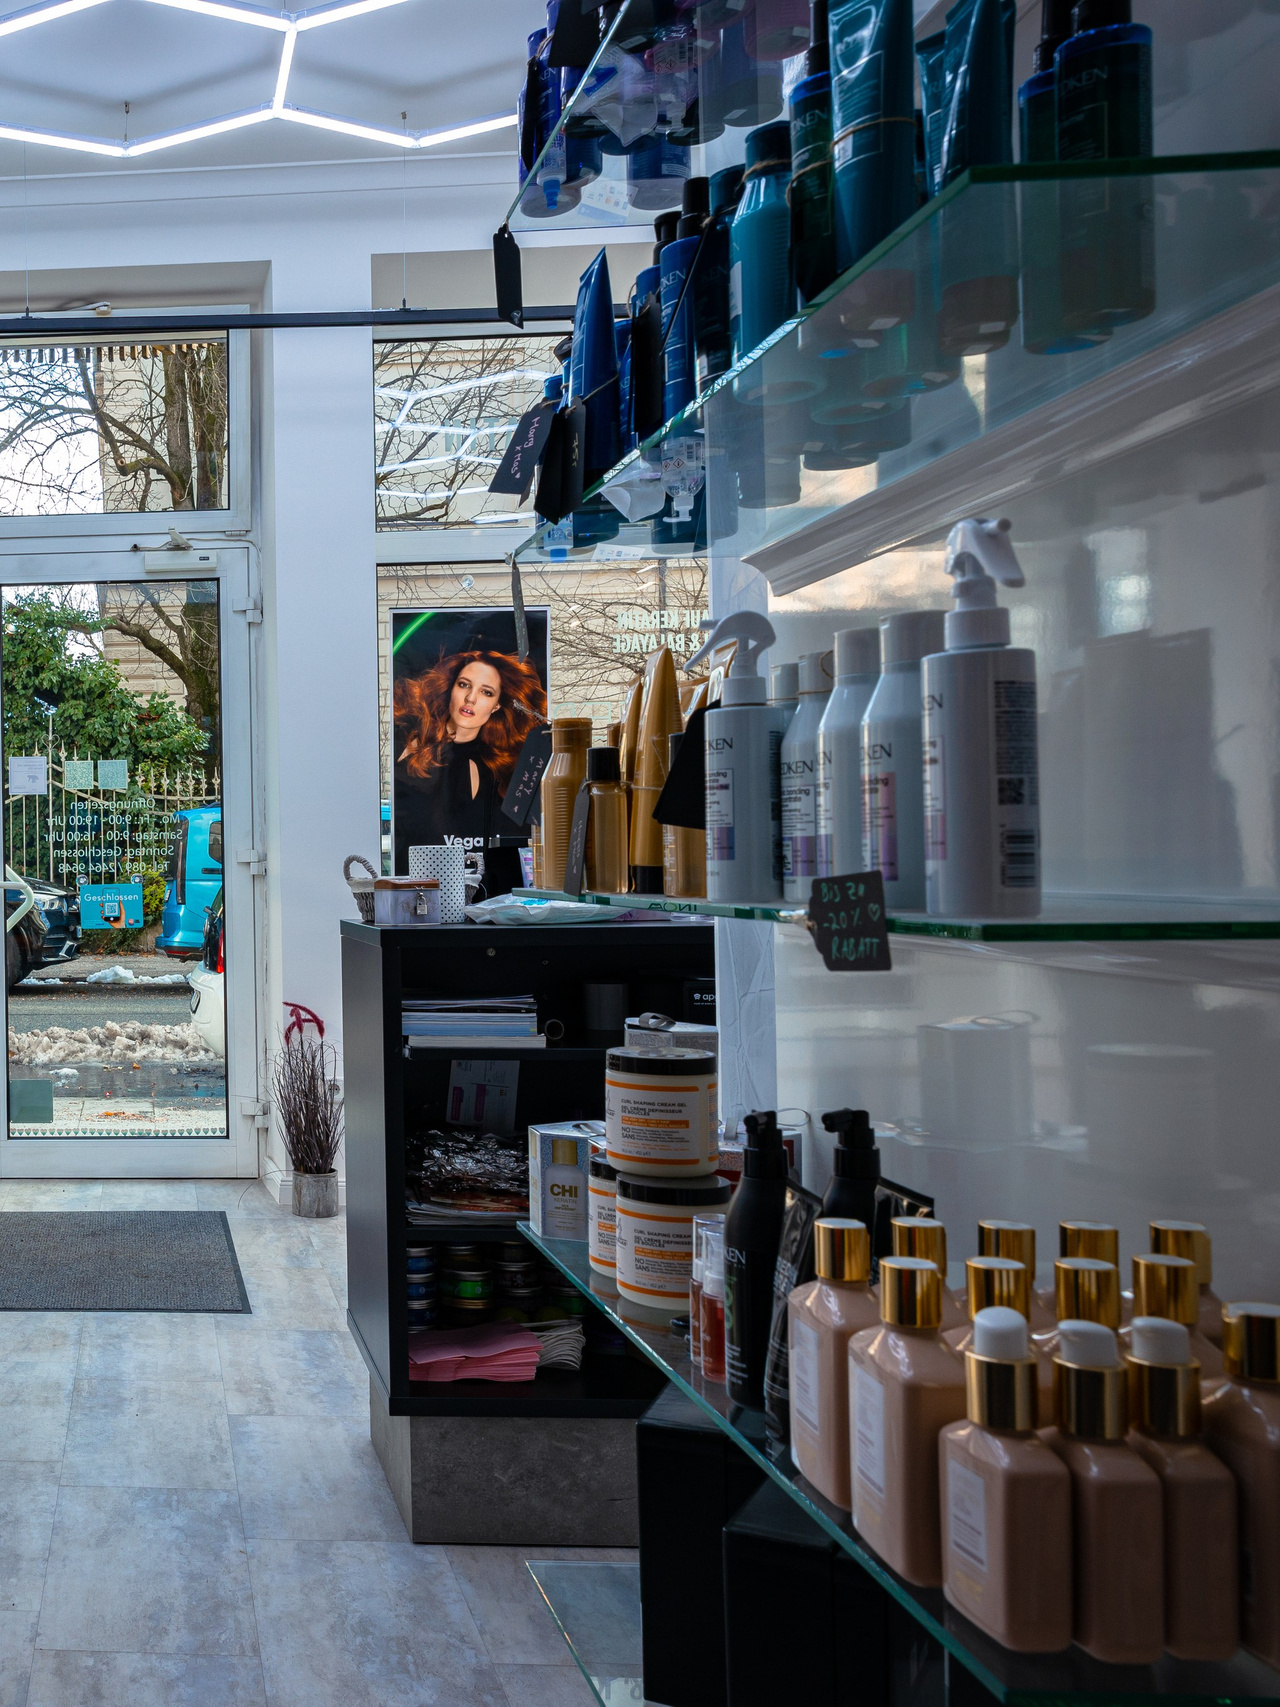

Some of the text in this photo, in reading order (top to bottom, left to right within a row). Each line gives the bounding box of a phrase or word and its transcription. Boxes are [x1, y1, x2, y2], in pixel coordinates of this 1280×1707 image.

[443, 834, 484, 850] Vega
[84, 893, 138, 901] Geschlossen
[832, 936, 880, 961] RABATT
[550, 1184, 578, 1198] CHI
[598, 1238, 609, 1246] SANS
[635, 1264, 650, 1272] SANS
